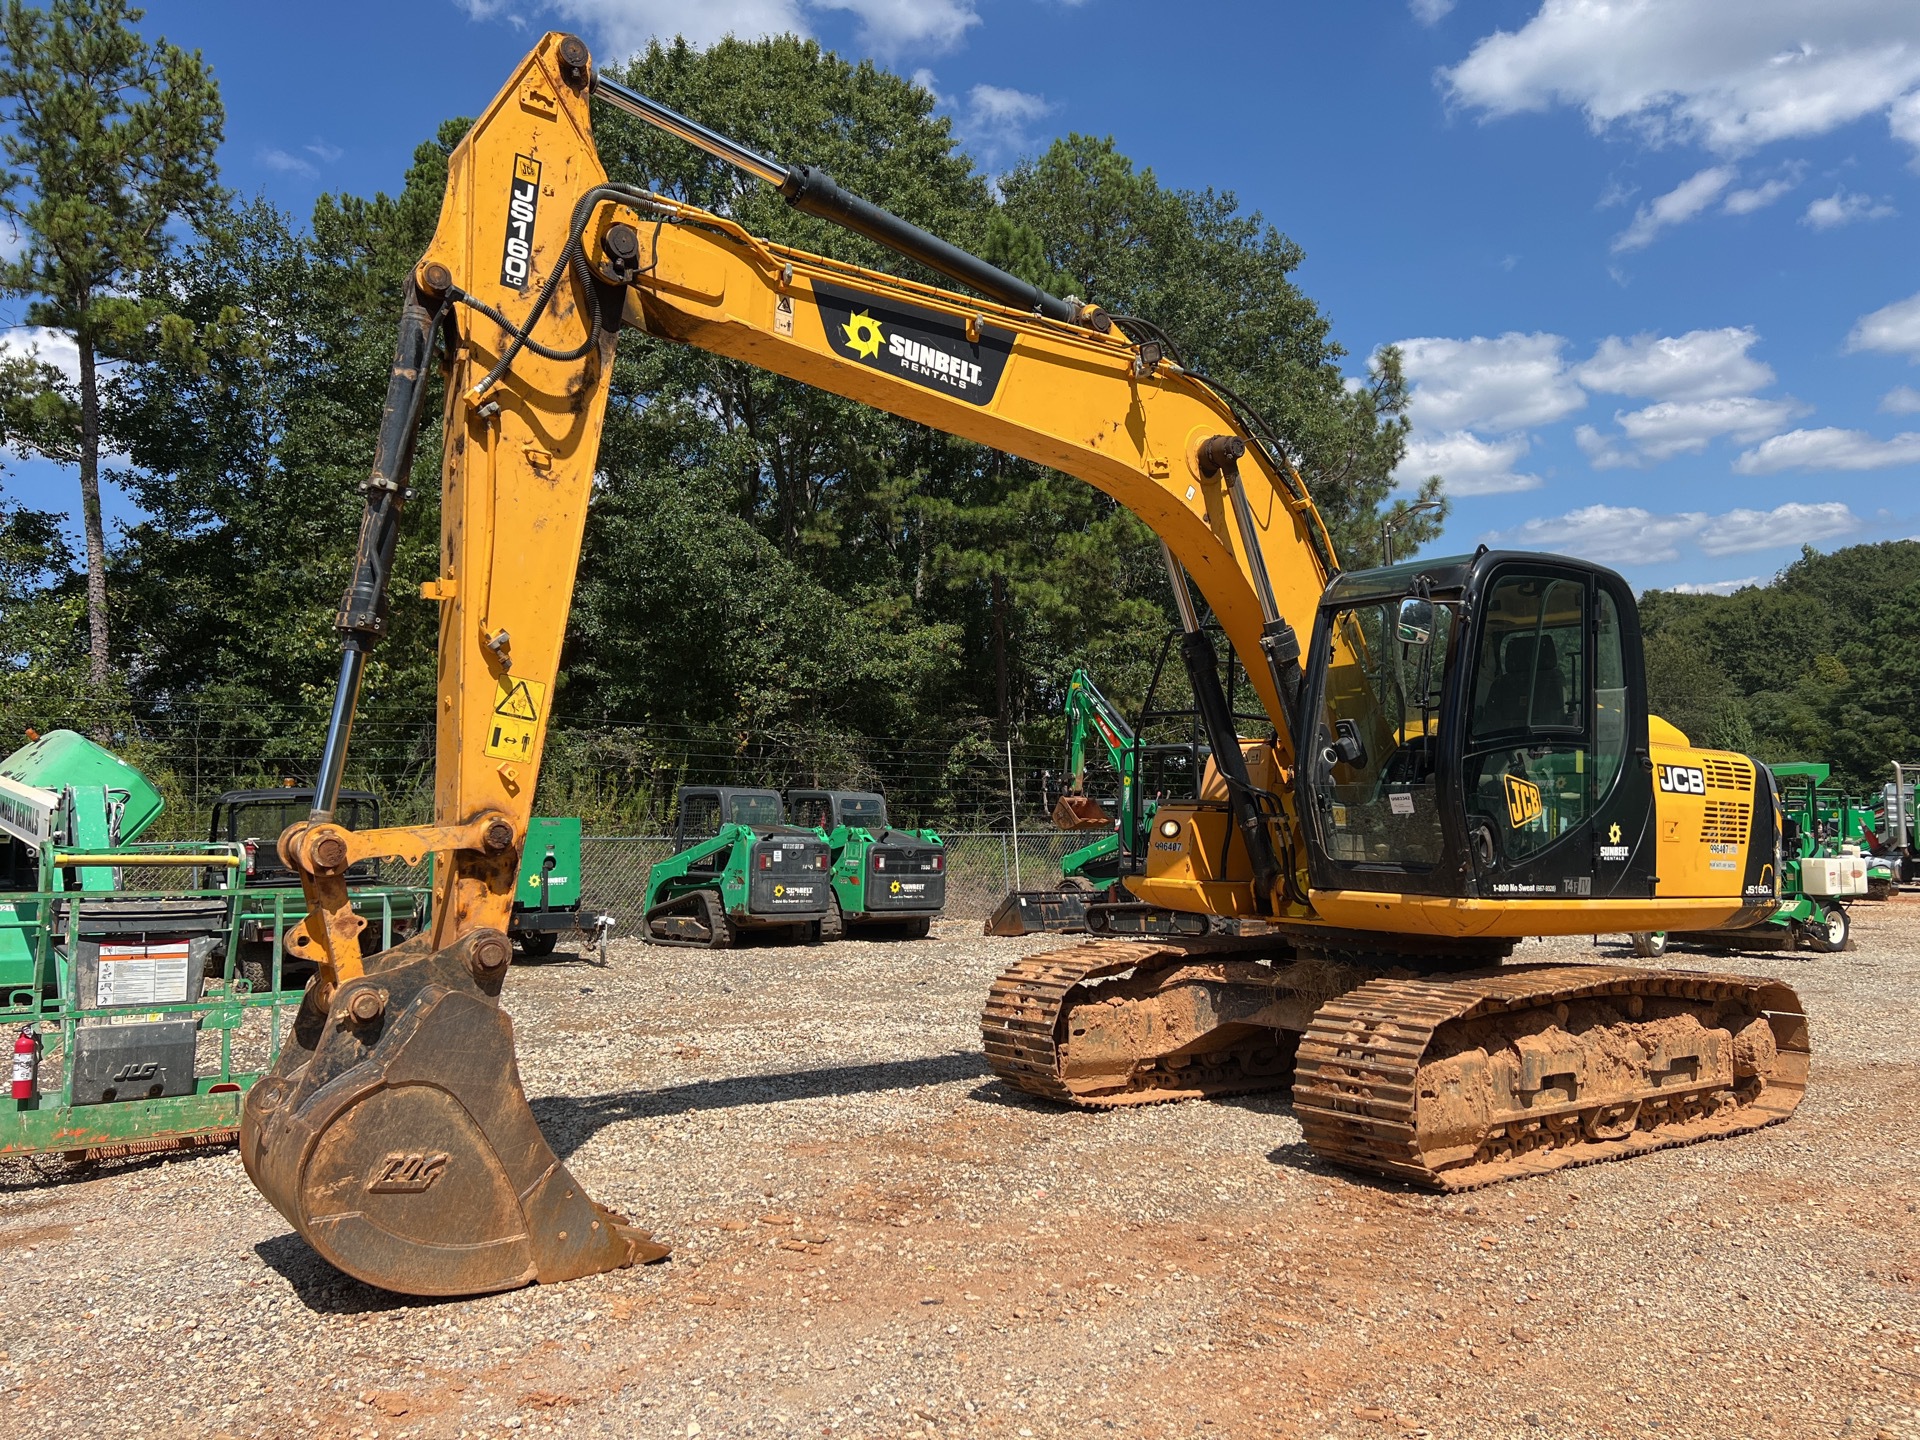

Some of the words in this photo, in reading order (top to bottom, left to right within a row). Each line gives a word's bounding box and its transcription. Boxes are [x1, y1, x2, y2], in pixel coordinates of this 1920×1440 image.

[504, 183, 535, 279] JS160
[506, 274, 523, 286] LC
[888, 333, 982, 385] SUNBELT
[900, 358, 967, 390] RENTALS
[1660, 766, 1705, 794] JCB
[1511, 780, 1541, 822] JCB
[1155, 841, 1182, 851] 996407
[1600, 846, 1629, 857] SUNBELT
[1492, 884, 1509, 892] 1-800
[1509, 883, 1518, 892] No
[1518, 883, 1536, 892] Sweat
[1745, 885, 1768, 895] JS160
[113, 1062, 158, 1083] JLG
